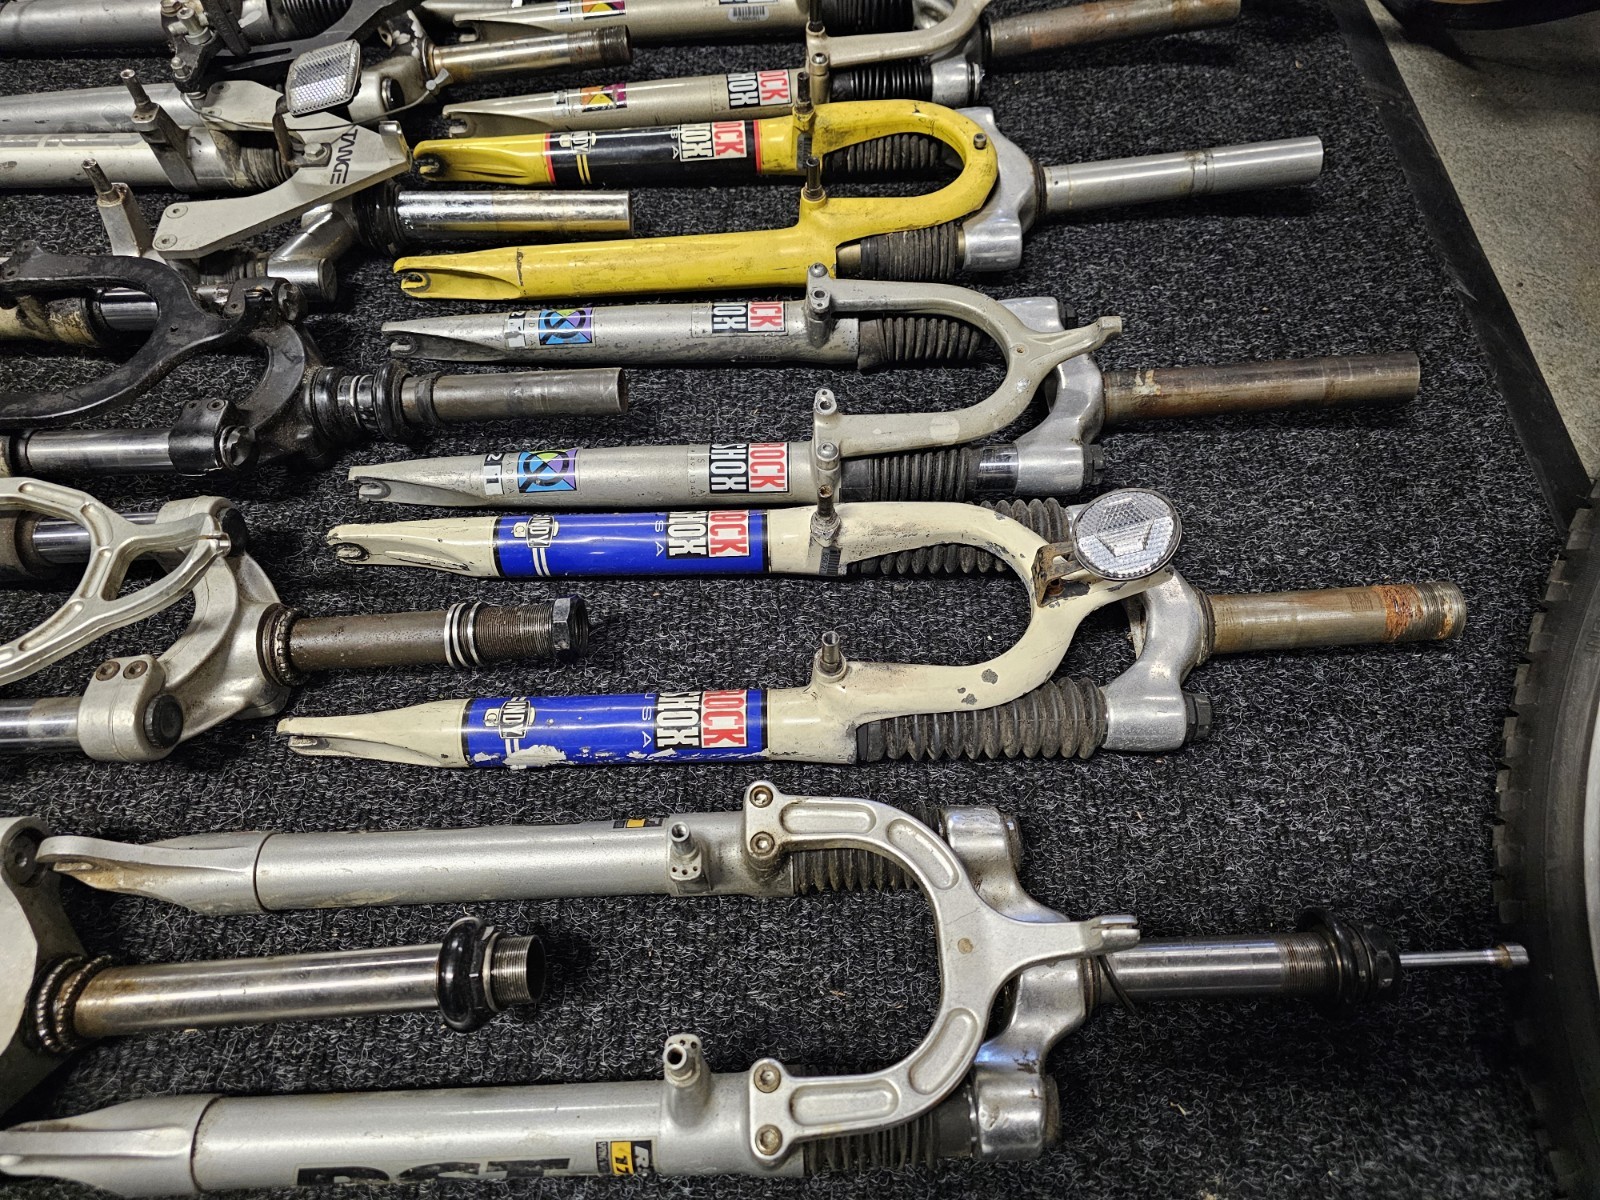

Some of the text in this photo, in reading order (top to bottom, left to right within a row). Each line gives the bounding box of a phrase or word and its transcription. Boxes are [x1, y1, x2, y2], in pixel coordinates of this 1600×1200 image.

[727, 72, 759, 106] HOX
[759, 71, 789, 100] OCK
[680, 123, 712, 159] HOX
[713, 121, 744, 156] OCK
[330, 129, 358, 184] TANGE
[499, 701, 527, 736] INDY
